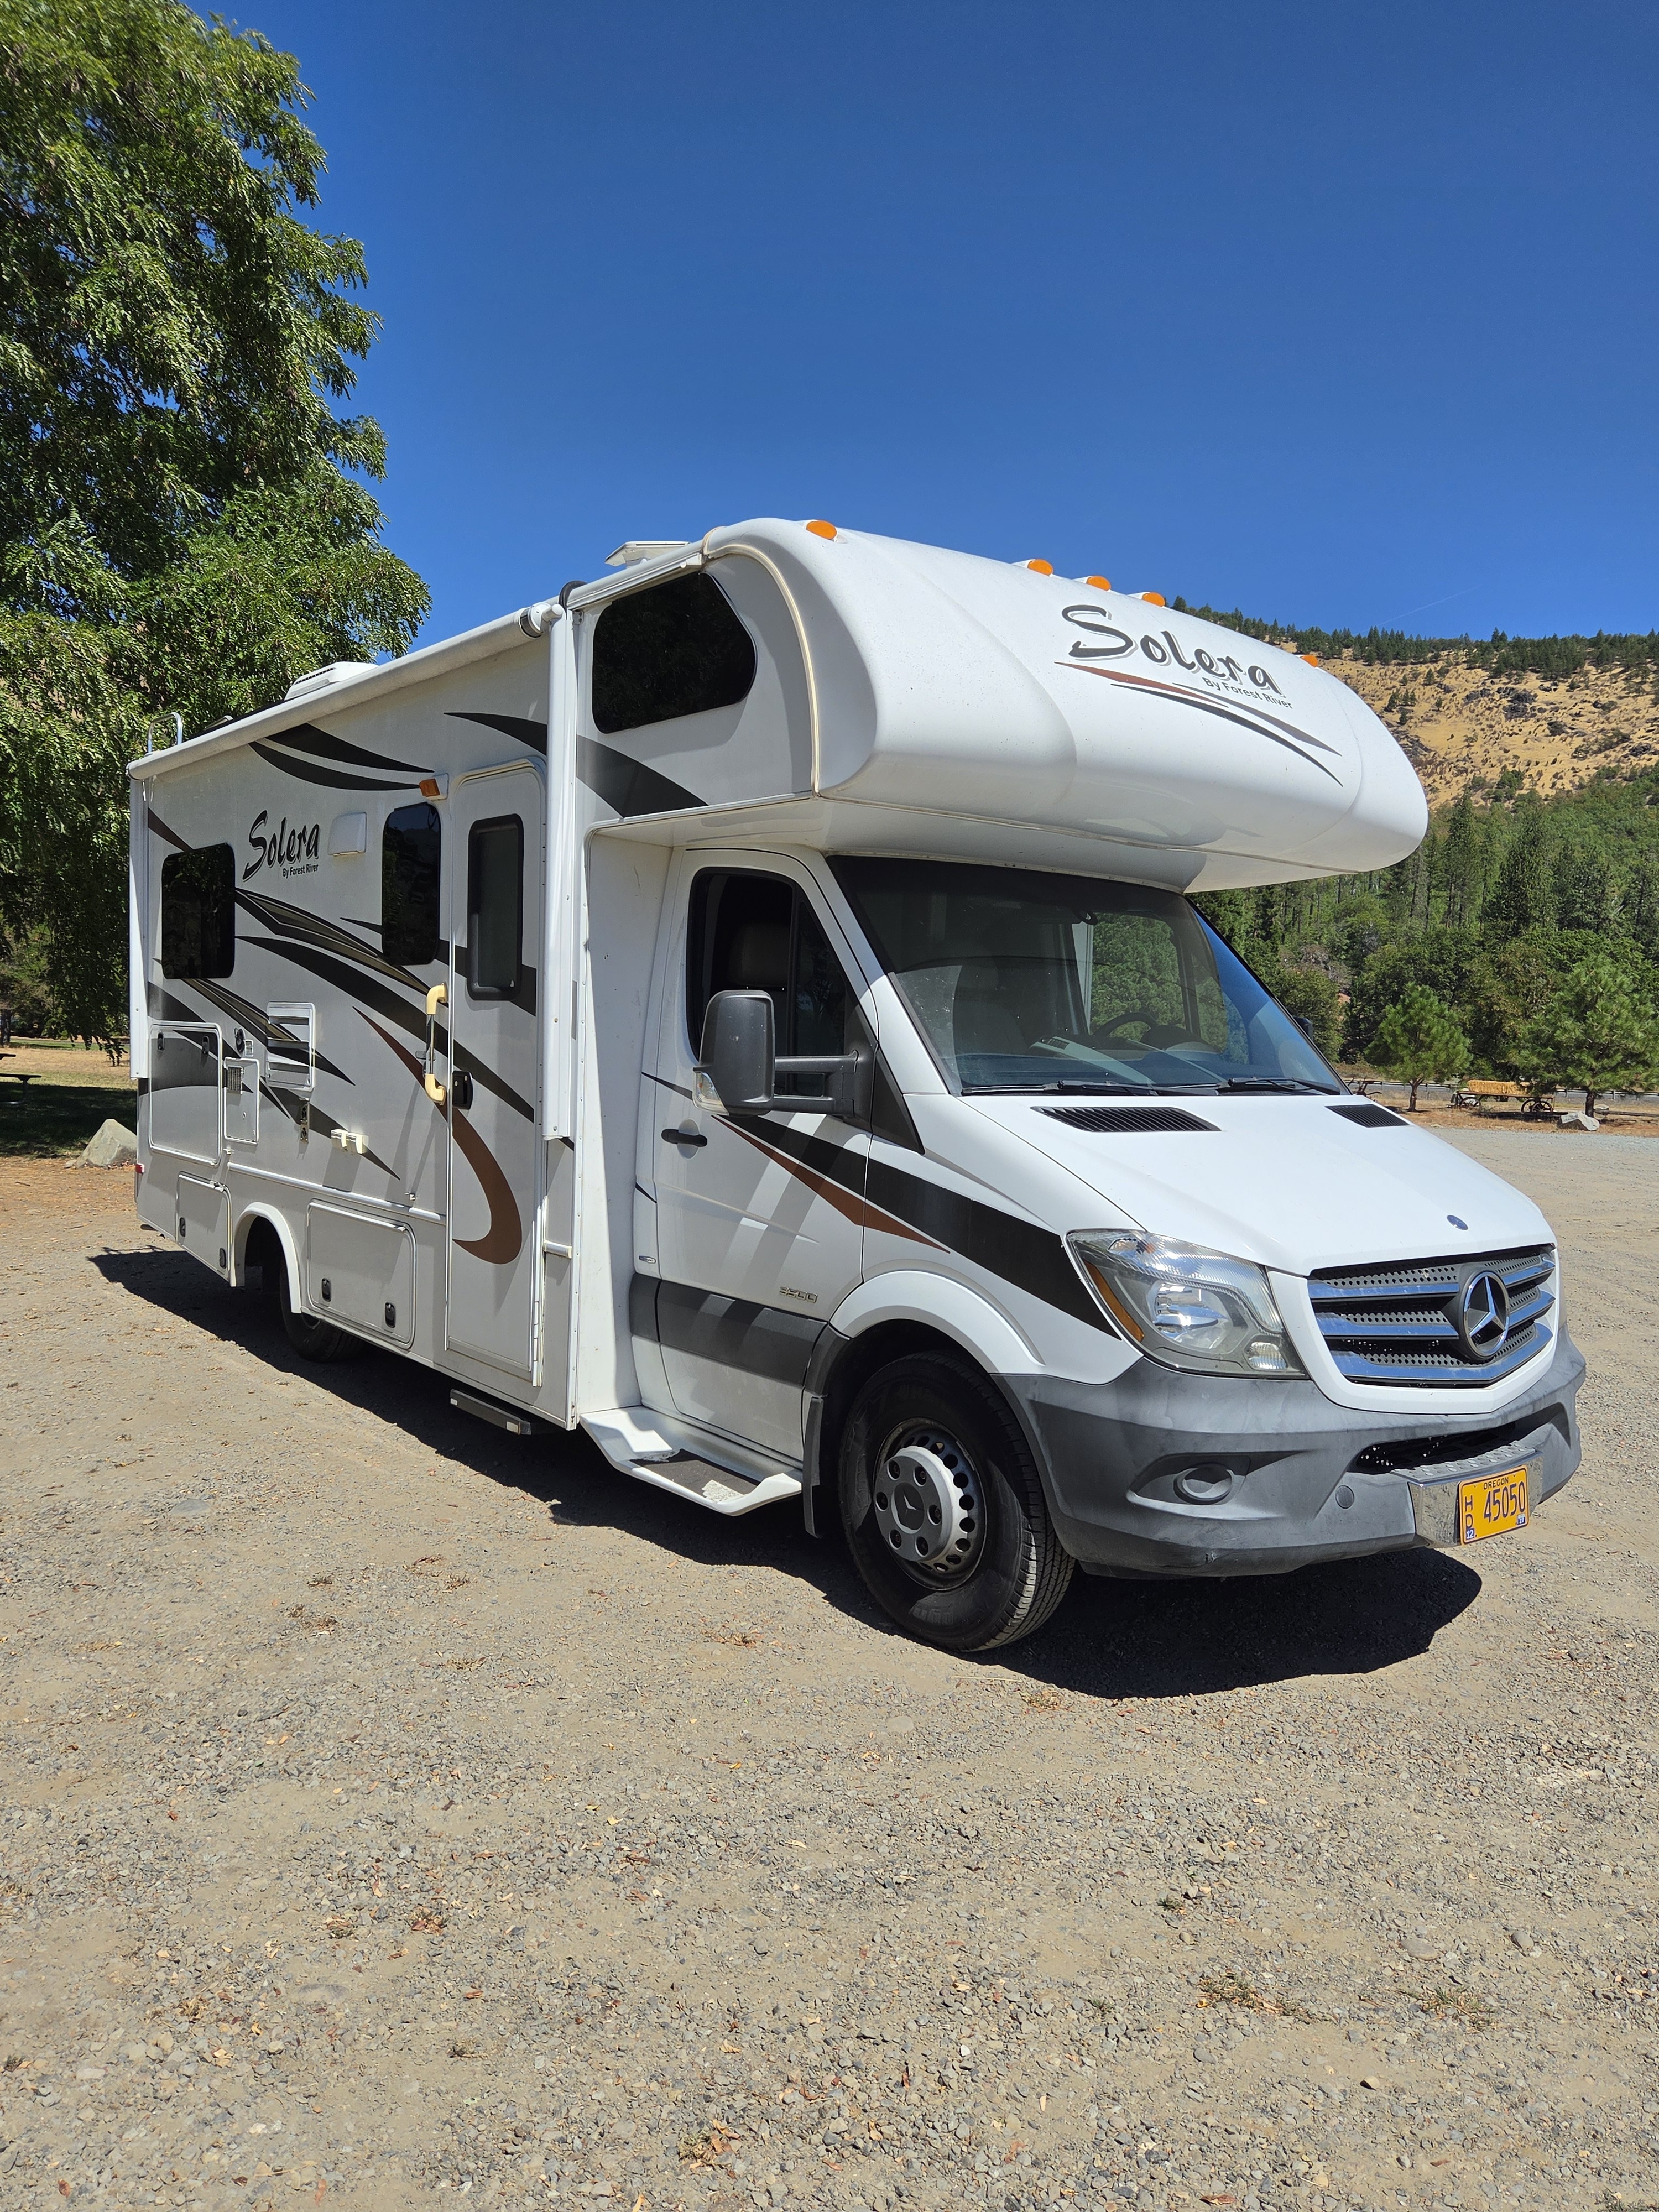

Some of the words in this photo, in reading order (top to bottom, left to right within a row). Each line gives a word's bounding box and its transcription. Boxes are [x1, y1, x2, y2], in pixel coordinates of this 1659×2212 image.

[1061, 604, 1287, 699] Solera
[1202, 677, 1222, 691] By
[1222, 682, 1263, 701] Forest
[1262, 693, 1293, 709] River
[242, 810, 321, 883] Solera
[283, 868, 289, 879] By
[290, 867, 305, 876] Forest
[306, 863, 319, 873] River
[779, 1286, 818, 1304] 3500
[1483, 1477, 1509, 1490] OREGON
[1484, 1481, 1526, 1523] 45050
[1467, 1529, 1474, 1539] 12
